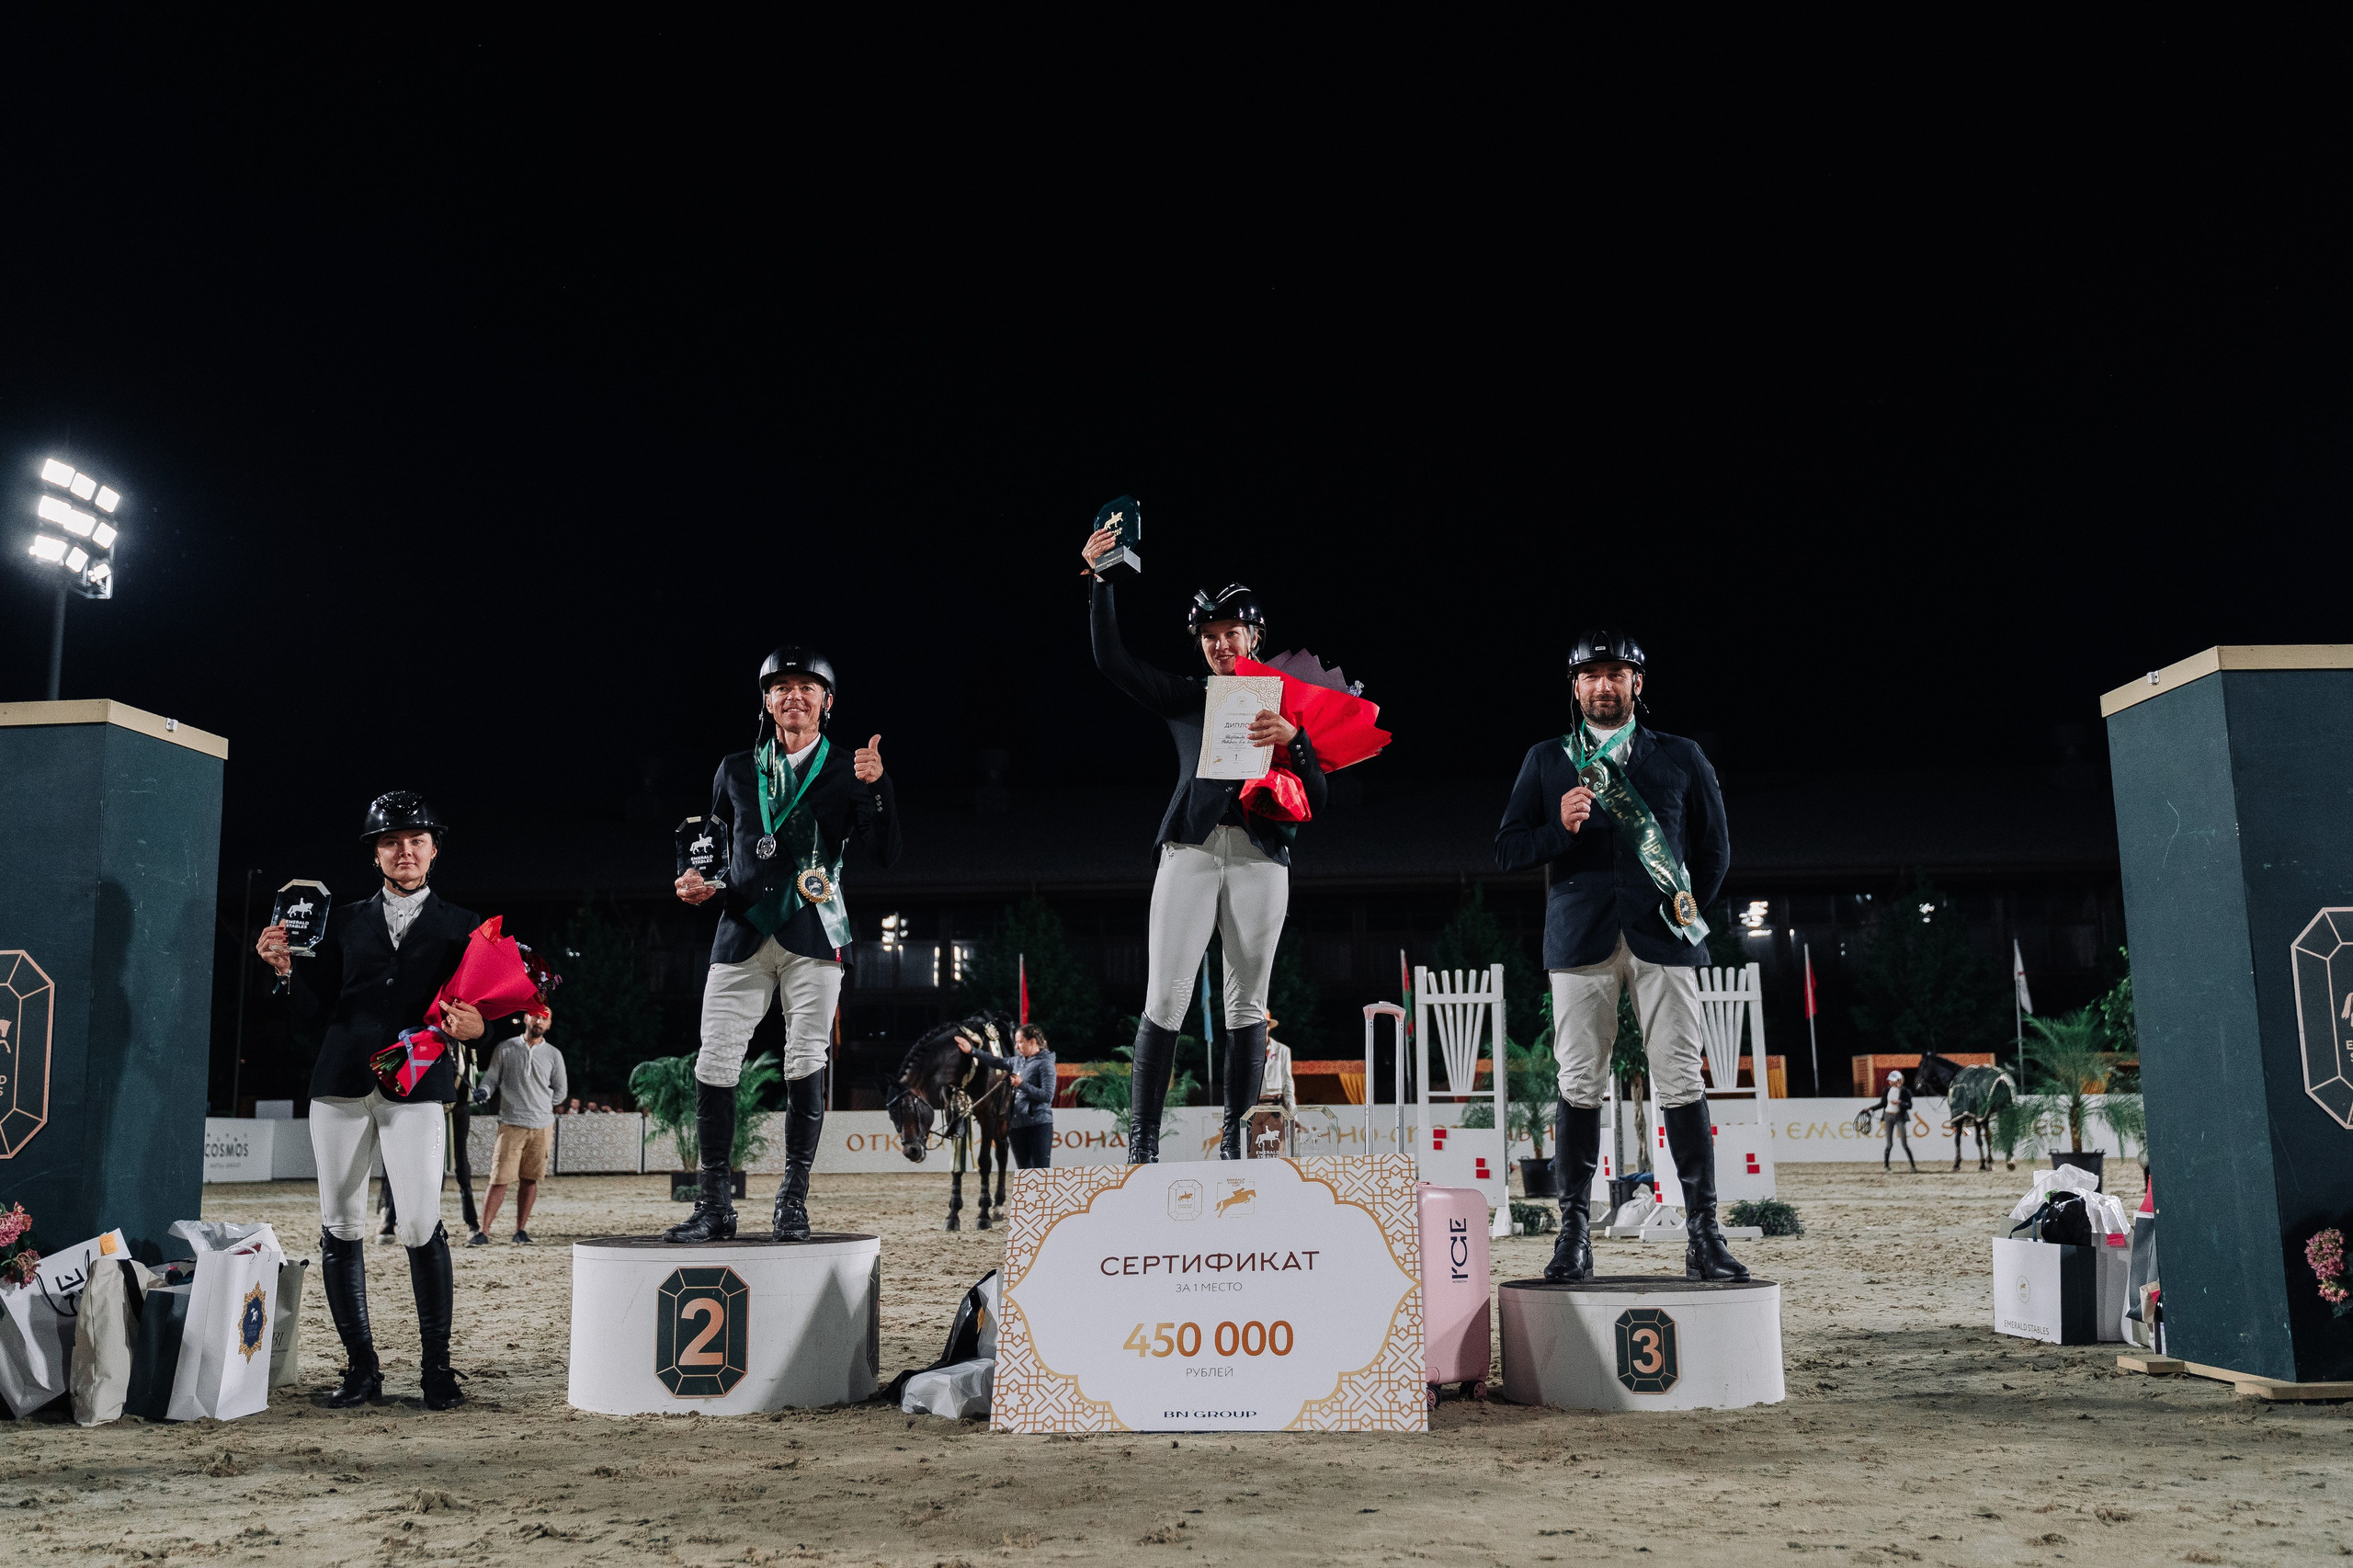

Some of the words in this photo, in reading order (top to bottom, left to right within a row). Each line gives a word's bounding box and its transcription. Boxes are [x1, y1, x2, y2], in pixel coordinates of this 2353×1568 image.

[205, 1142, 249, 1158] COSMOS
[1100, 1250, 1320, 1277] СЕРТИФИКАТ
[1176, 1283, 1190, 1292] ЗА
[1193, 1283, 1198, 1292] 1
[1200, 1282, 1243, 1291] МЕСТО
[677, 1297, 725, 1366] 2
[2004, 1319, 2028, 1332] EMERALD
[2028, 1324, 2050, 1335] STABLES
[1122, 1321, 1202, 1358] 450
[1214, 1320, 1294, 1357] 000
[1631, 1327, 1663, 1374] 3
[1186, 1366, 1233, 1377] РУБЛЕЙ
[1193, 1410, 1257, 1418] GROUP
